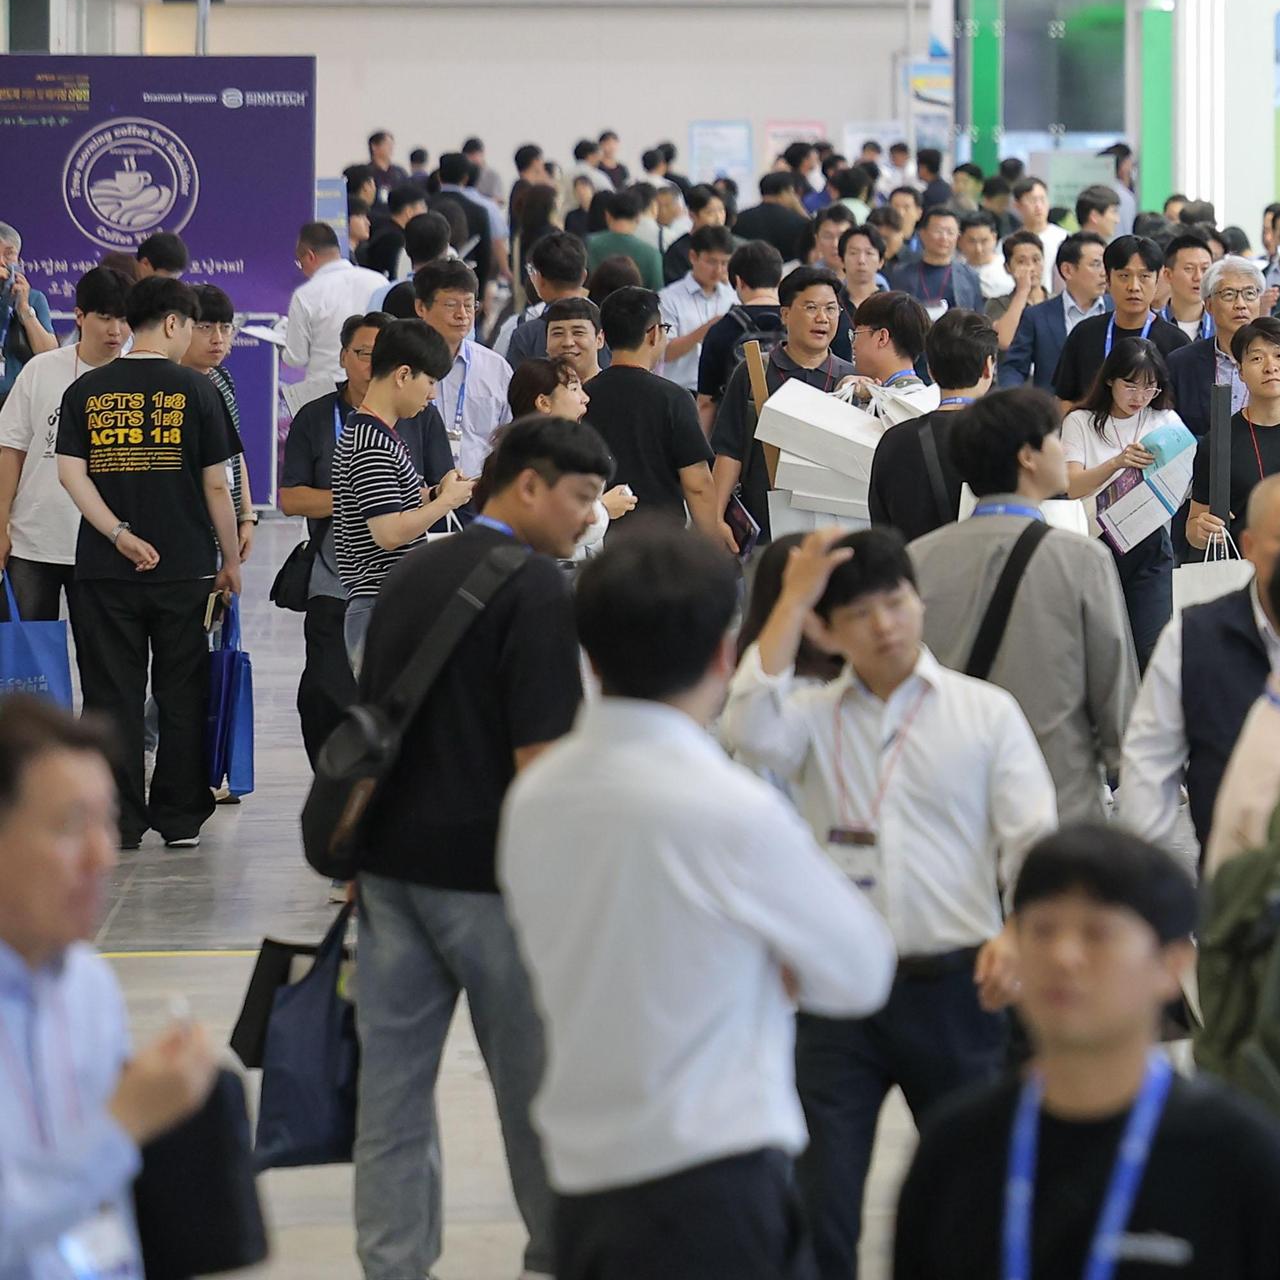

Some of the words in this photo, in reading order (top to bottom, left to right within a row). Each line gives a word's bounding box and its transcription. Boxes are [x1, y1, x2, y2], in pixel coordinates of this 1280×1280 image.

[113, 124, 150, 138] coffee
[85, 393, 144, 413] ACTS
[152, 391, 186, 410] 1:8
[87, 410, 144, 430] ACTS
[151, 409, 183, 427] 1:8
[91, 428, 143, 445] ACTS
[150, 428, 181, 444] 1:8
